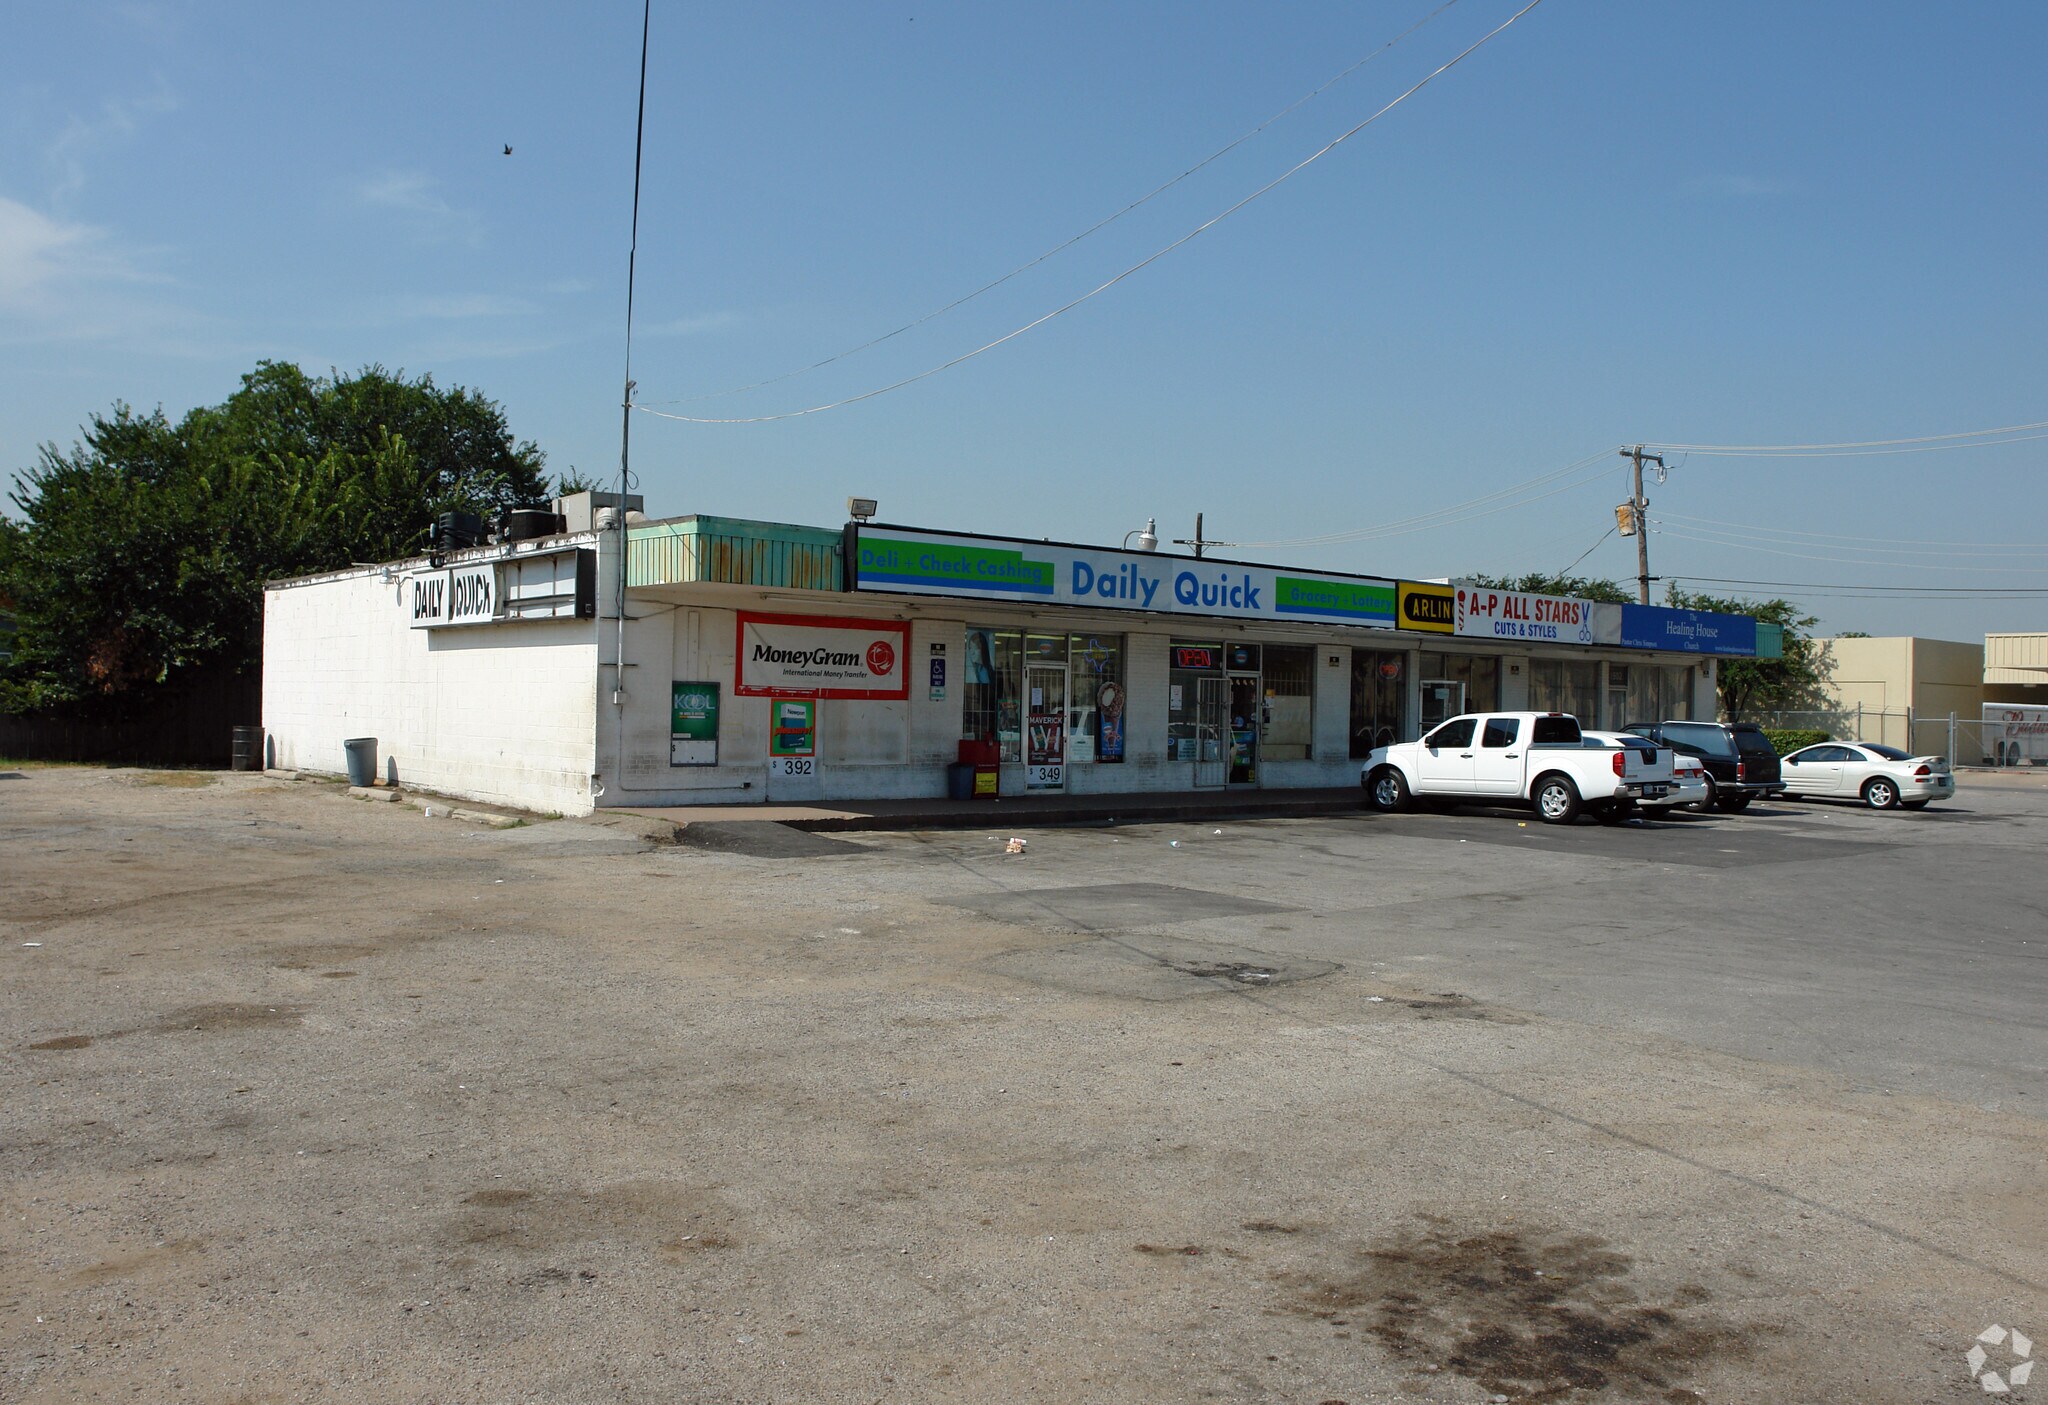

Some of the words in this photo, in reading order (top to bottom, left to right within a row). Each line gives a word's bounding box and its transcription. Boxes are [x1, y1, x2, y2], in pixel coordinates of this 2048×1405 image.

[862, 550, 898, 568] Deli
[920, 554, 970, 574] Check
[976, 559, 1042, 583] Cashing
[1072, 561, 1160, 607] Daily
[1174, 571, 1260, 609] Quick
[414, 579, 444, 619] DAILY
[455, 573, 490, 617] QUICK
[1290, 587, 1339, 607] Grocery
[1352, 596, 1393, 610] Lottery
[1412, 597, 1454, 619] ARLIN
[1470, 593, 1498, 616] A-P
[1503, 596, 1529, 620] ALL
[1535, 599, 1579, 624] STARS
[1689, 613, 1697, 621] The
[1494, 621, 1516, 636] CUTS
[1519, 624, 1525, 636] &
[1528, 624, 1557, 638] STYLES
[1666, 620, 1695, 639] Healing
[1696, 624, 1718, 638] House
[1684, 641, 1699, 650] Church
[752, 645, 859, 668] MoneyGram
[1180, 650, 1210, 666] OPEN
[782, 668, 822, 677] International
[823, 670, 843, 679] Money
[674, 694, 715, 709] KOOL
[1029, 716, 1063, 724] MAVERICK
